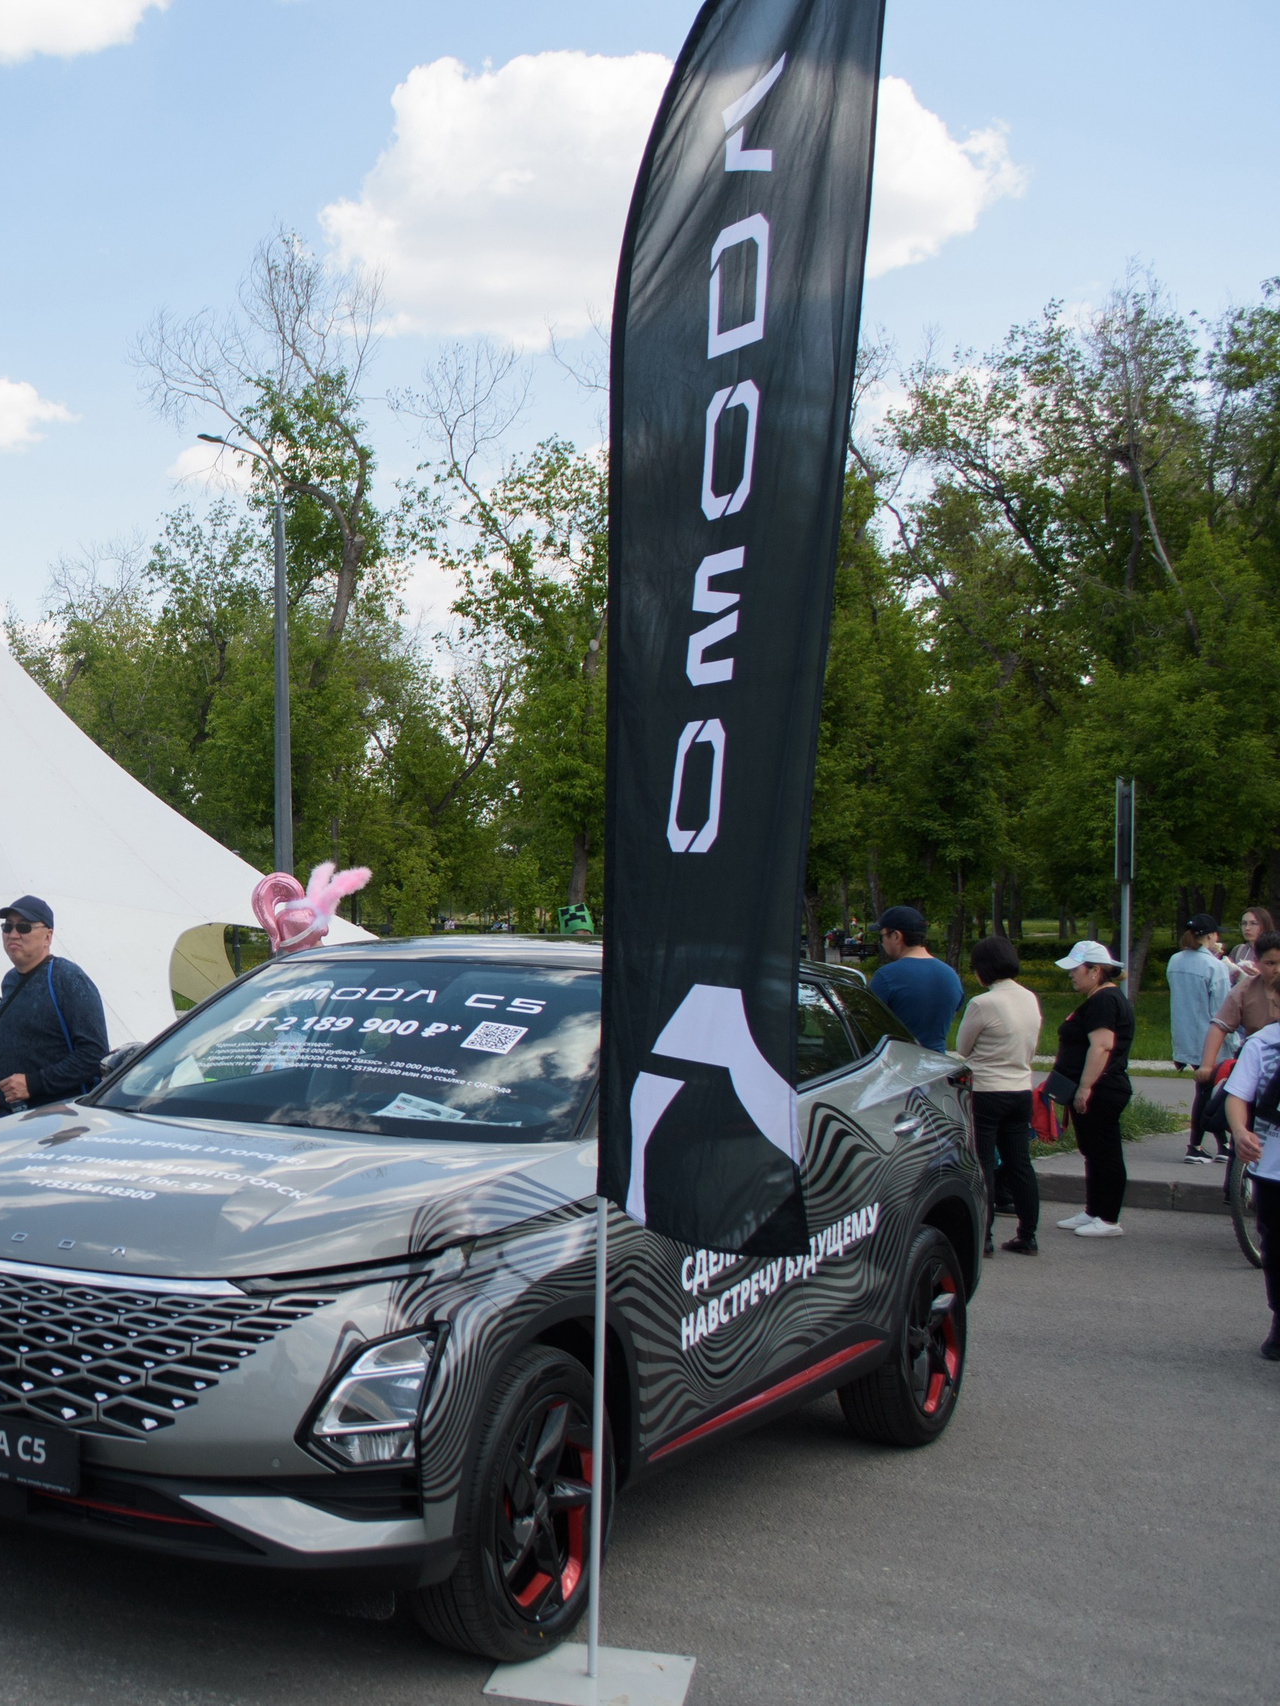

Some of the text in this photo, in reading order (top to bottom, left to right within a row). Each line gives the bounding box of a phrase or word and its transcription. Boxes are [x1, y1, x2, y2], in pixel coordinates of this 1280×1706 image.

[666, 51, 787, 854] OMODA
[261, 987, 547, 1015] OMODA C5
[232, 1017, 277, 1032] ОТ
[273, 1016, 298, 1031] 2
[301, 1016, 354, 1032] 189
[358, 1017, 420, 1036] 900
[351, 1064, 401, 1076] 3519418300
[402, 1070, 419, 1078] или
[420, 1072, 432, 1080] по
[433, 1074, 466, 1086] ссылке
[474, 1081, 489, 1090] QR
[489, 1085, 511, 1095] кода
[405, 1062, 422, 1070] 000
[219, 1147, 308, 1167] ГОРОДЕ!
[184, 1180, 215, 1192] 57
[681, 1257, 783, 1351] НАВСТРЕЧУ
[17, 1435, 47, 1465] C5
